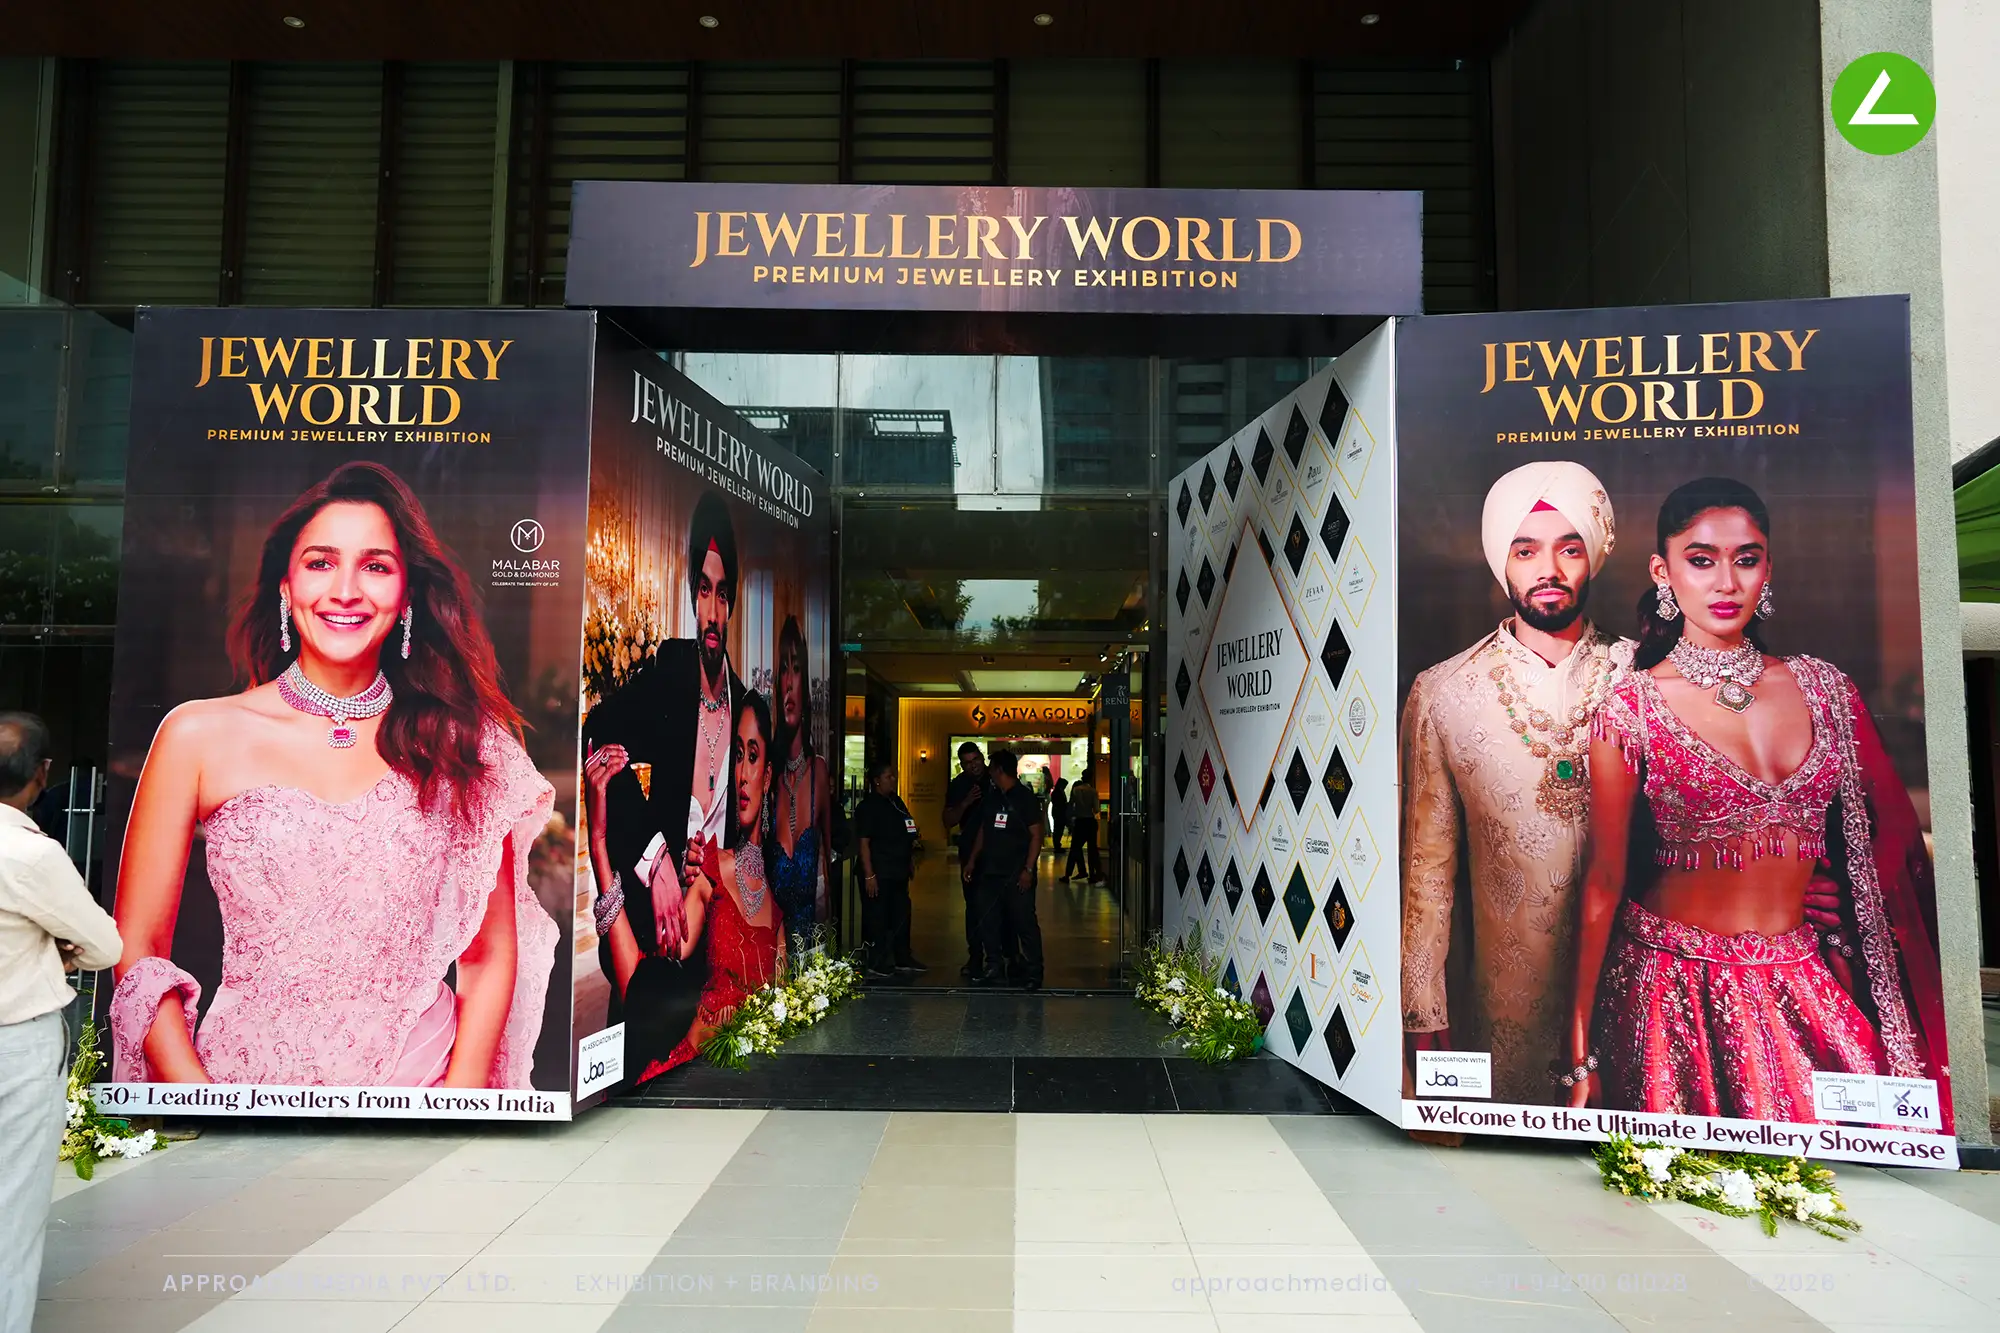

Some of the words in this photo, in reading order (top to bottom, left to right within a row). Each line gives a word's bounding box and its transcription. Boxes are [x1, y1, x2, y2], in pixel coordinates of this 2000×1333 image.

[689, 211, 1048, 268] JEWELLERY
[1060, 214, 1303, 264] WORLD
[753, 265, 885, 285] PREMIUM
[896, 267, 1062, 287] JEWELLERY
[1075, 269, 1238, 288] EXHIBITION
[195, 336, 514, 388] JEWELLERY
[1480, 329, 1820, 394] JEWELLERY
[246, 383, 461, 426] WORLD
[1533, 378, 1764, 426] WORLD
[207, 429, 284, 441] PREMIUM
[291, 430, 388, 442] JEWELLERY
[395, 431, 492, 443] EXHIBITION
[631, 369, 753, 482] JEWELLERY
[755, 452, 813, 517] WORLD
[1497, 431, 1577, 443] PREMIUM
[1583, 427, 1686, 441] JEWELLERY
[1694, 423, 1800, 437] EXHIBITION
[656, 436, 704, 477] PREMIUM
[707, 466, 756, 506] JEWELLERY
[758, 497, 799, 529] EXHIBITION
[492, 559, 560, 570] MALABAR
[1216, 628, 1283, 674] JEWELLERY
[1227, 669, 1272, 699] WORLD
[992, 707, 1038, 720] SATVA
[1042, 707, 1087, 720] GOLD
[1219, 708, 1235, 716] PREMIUM
[1235, 705, 1257, 714] JEWELLERY
[1257, 703, 1281, 713] EXHIBITION
[148, 1087, 240, 1111] Leading
[246, 1088, 350, 1110] Jewellers
[356, 1090, 411, 1109] from
[419, 1091, 490, 1112] Across
[497, 1092, 556, 1114] India
[1897, 1104, 1929, 1119] BXI
[1416, 1105, 1516, 1130] Welcome
[1521, 1109, 1546, 1129] to
[1551, 1109, 1591, 1134] the
[1597, 1113, 1697, 1141] Ultimate
[1700, 1120, 1813, 1157] Jewellery
[1819, 1129, 1946, 1160] Showcase
